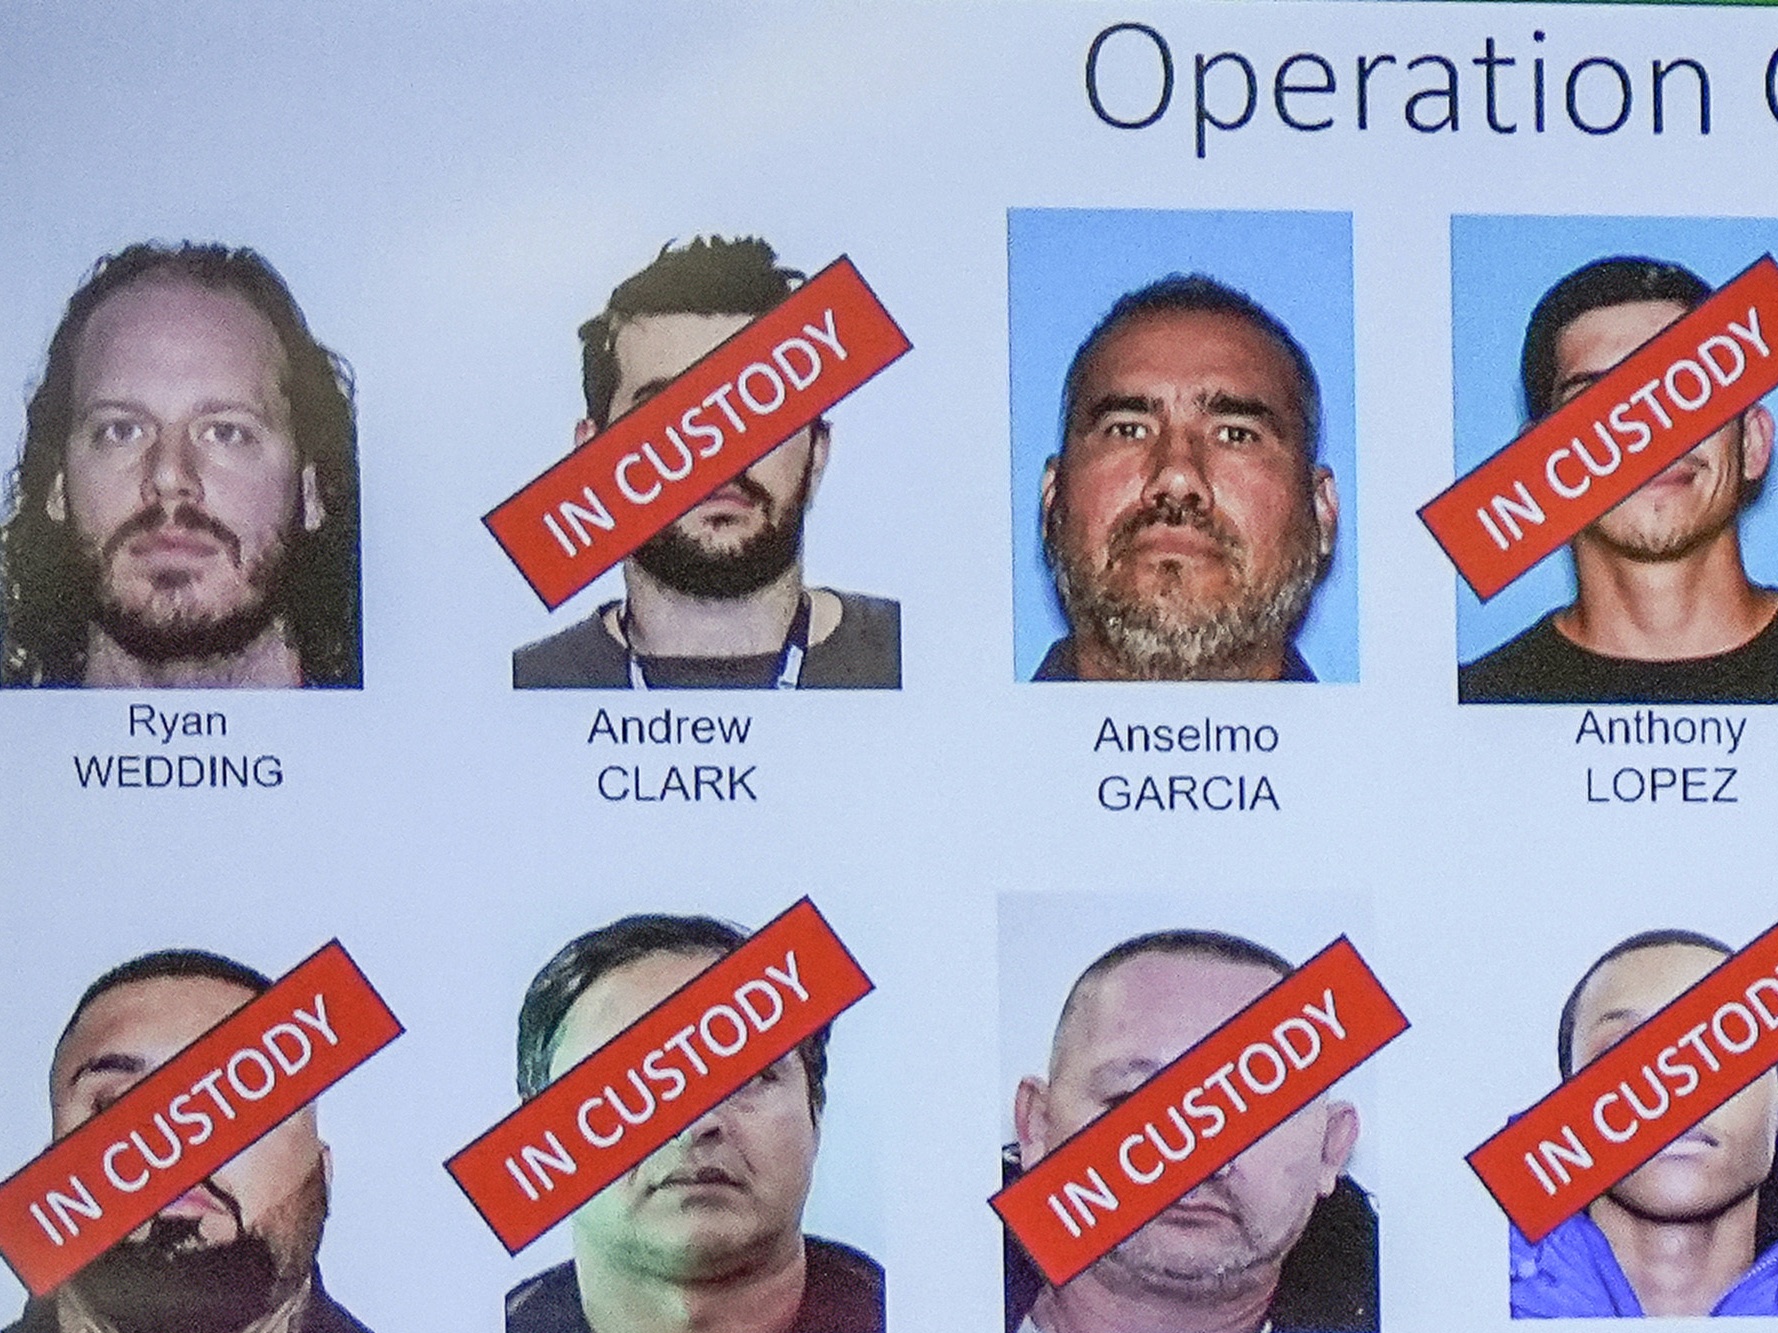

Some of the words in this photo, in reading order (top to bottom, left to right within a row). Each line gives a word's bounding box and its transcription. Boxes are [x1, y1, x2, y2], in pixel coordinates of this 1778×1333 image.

[1084, 21, 1712, 160] Operation
[543, 486, 616, 558] IN
[615, 308, 848, 505] CUSTODY
[1477, 480, 1546, 551] IN
[1545, 306, 1770, 499] CUSTODY
[128, 703, 228, 745] Ryan
[586, 707, 753, 745] Andrew
[1092, 716, 1280, 753] Anselmo
[1574, 708, 1748, 755] Anthony
[72, 754, 284, 789] WEDDING
[597, 764, 758, 803] CLARK
[1097, 774, 1281, 812] GARCIA
[1586, 766, 1739, 804] LOPEZ
[505, 1130, 577, 1201] IN
[577, 950, 809, 1148] CUSTODY
[29, 1175, 103, 1246] IN
[103, 993, 338, 1193] CUSTODY
[1048, 1166, 1119, 1238] IN
[1119, 988, 1346, 1184] CUSTODY
[1524, 1125, 1594, 1196] IN
